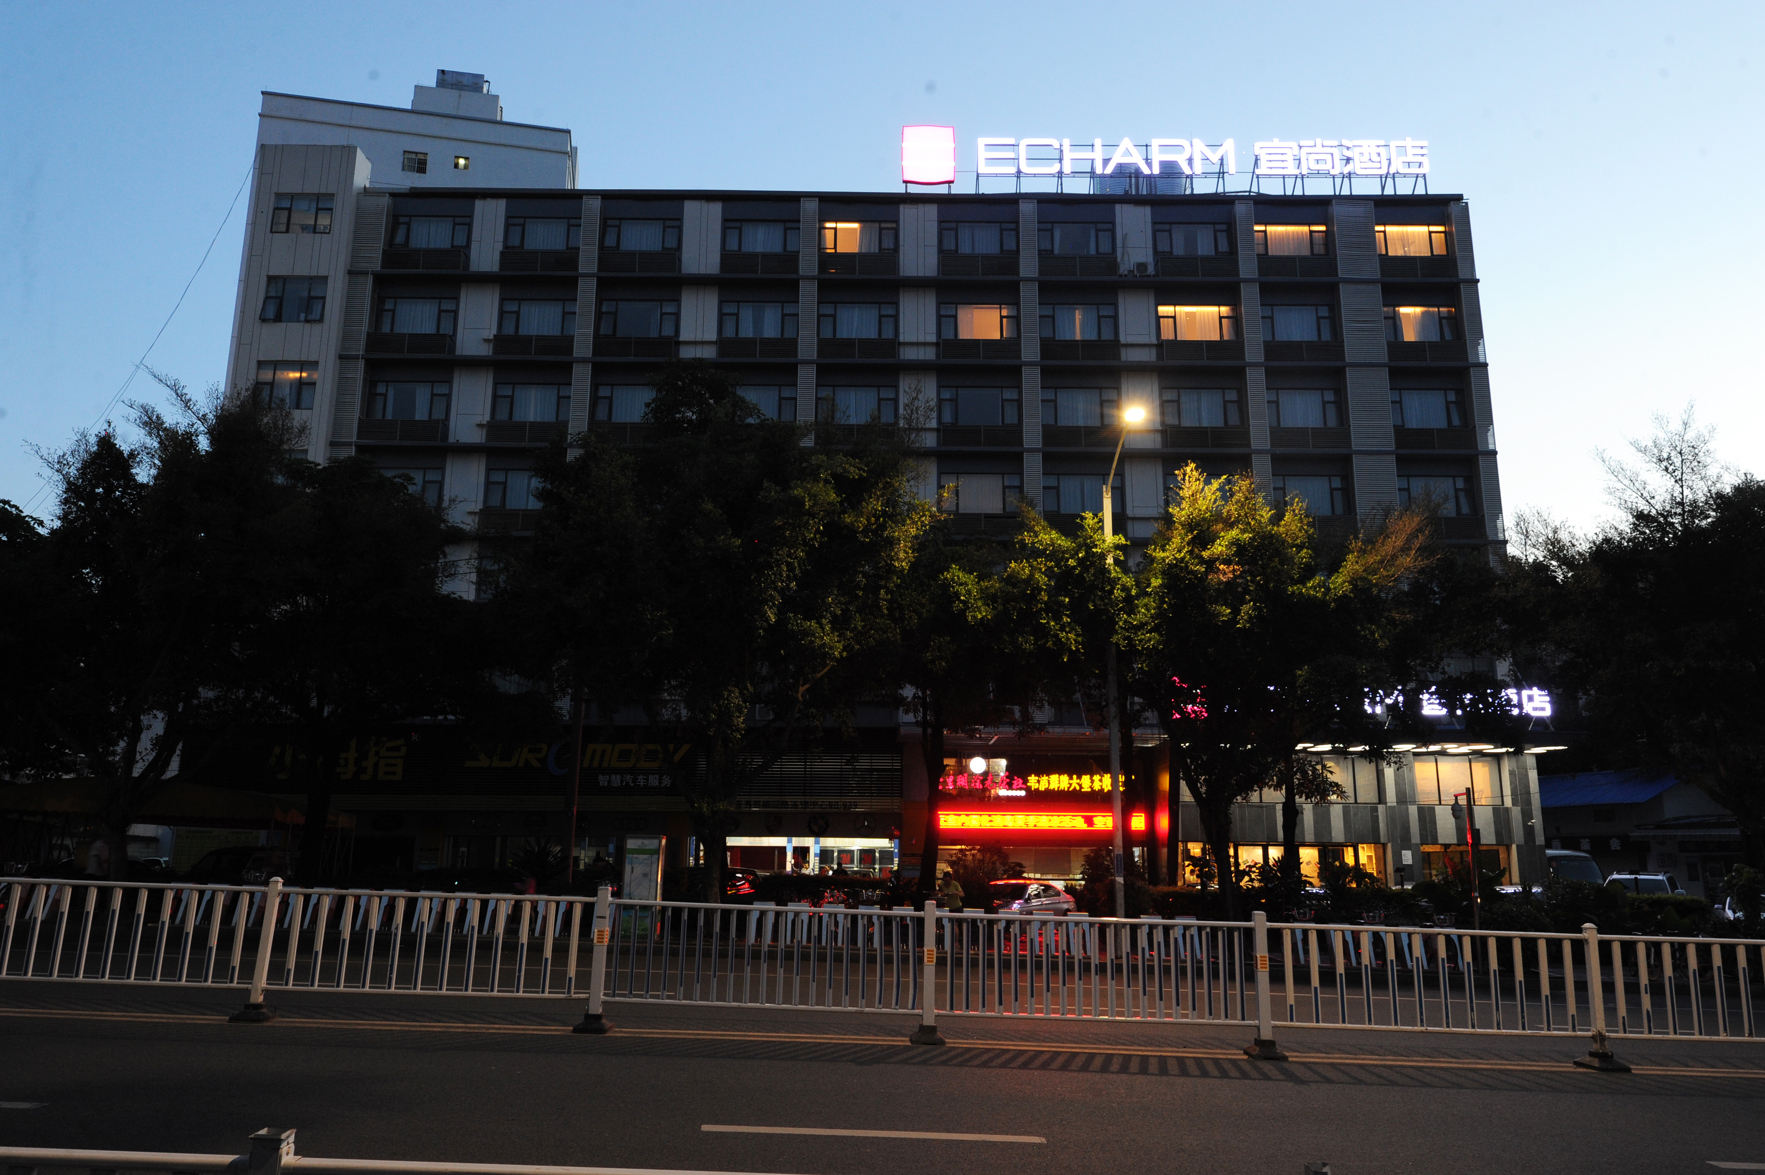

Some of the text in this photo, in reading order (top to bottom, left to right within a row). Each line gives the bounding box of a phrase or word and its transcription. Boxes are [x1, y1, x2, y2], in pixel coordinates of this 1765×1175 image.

[976, 136, 1236, 176] ECHARM
[1252, 136, 1430, 176] 宜尚酒店
[597, 774, 673, 788] 智慧汽车服务
